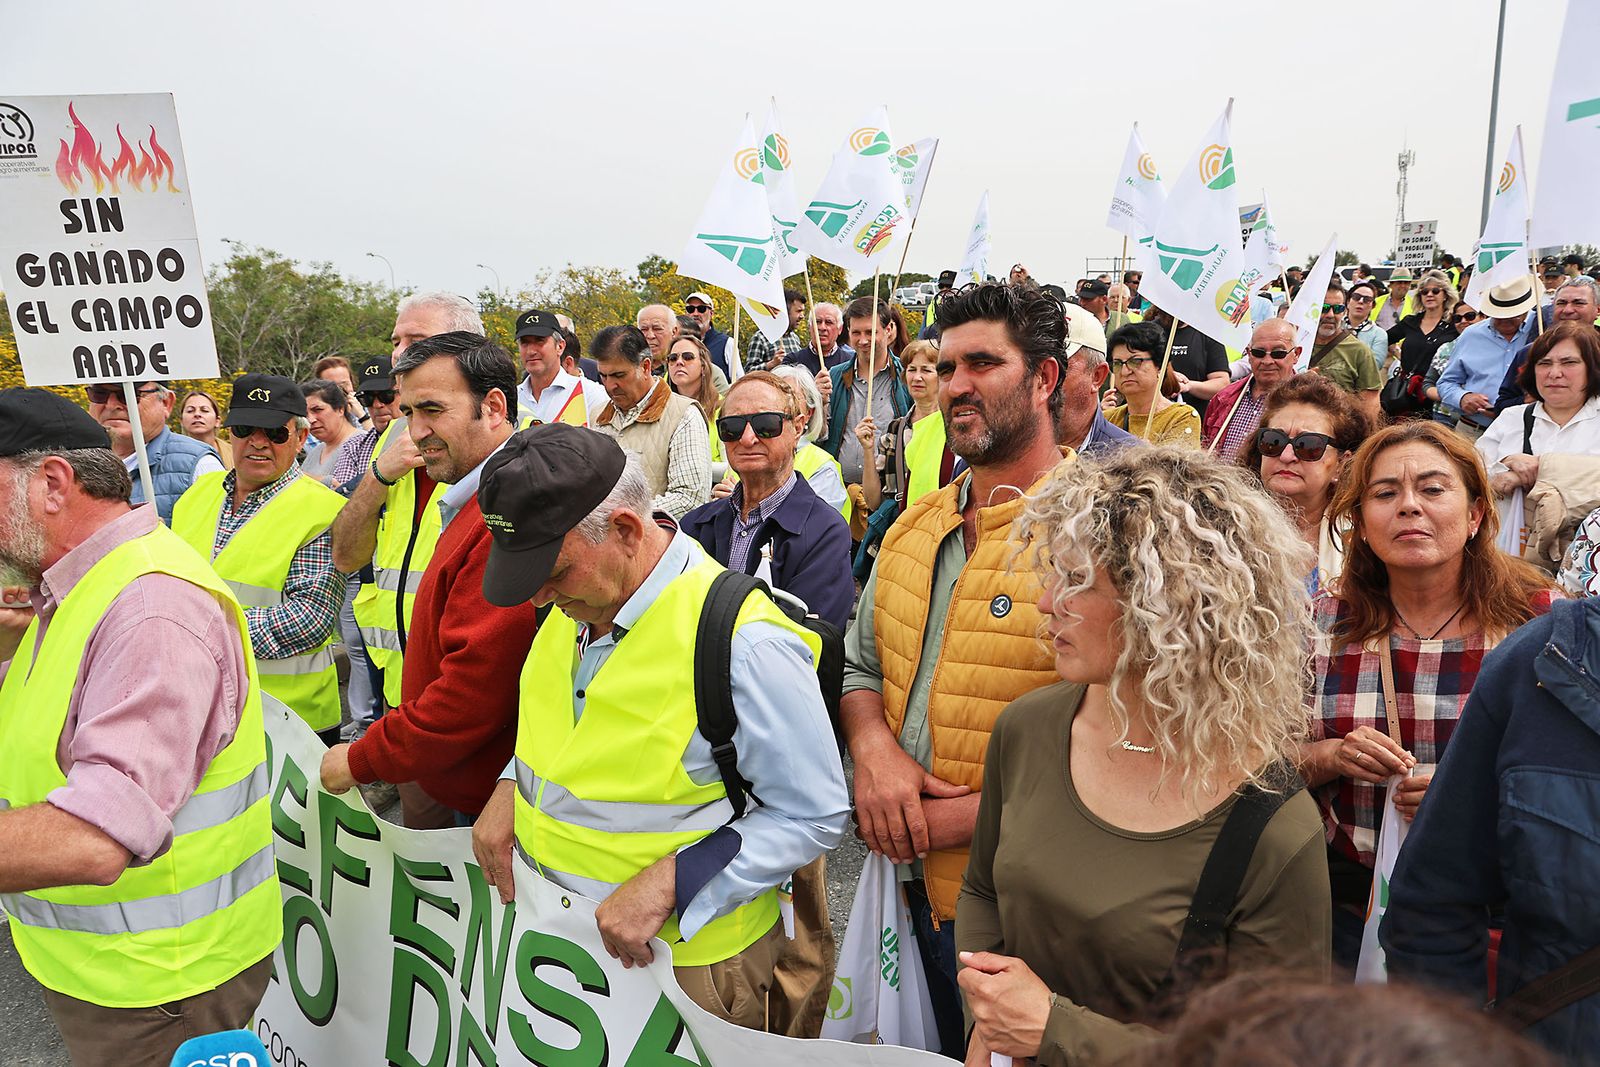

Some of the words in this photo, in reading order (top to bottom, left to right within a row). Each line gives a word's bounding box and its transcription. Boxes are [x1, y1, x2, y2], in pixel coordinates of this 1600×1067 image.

[0, 142, 37, 154] IPOR
[60, 197, 125, 234] SIN
[1405, 244, 1433, 252] PROBLEMA
[1405, 252, 1424, 260] SOMOS
[16, 248, 185, 288] GANADO
[16, 300, 60, 335] EL
[70, 294, 204, 332] CAMPO
[72, 342, 170, 379] ARDE
